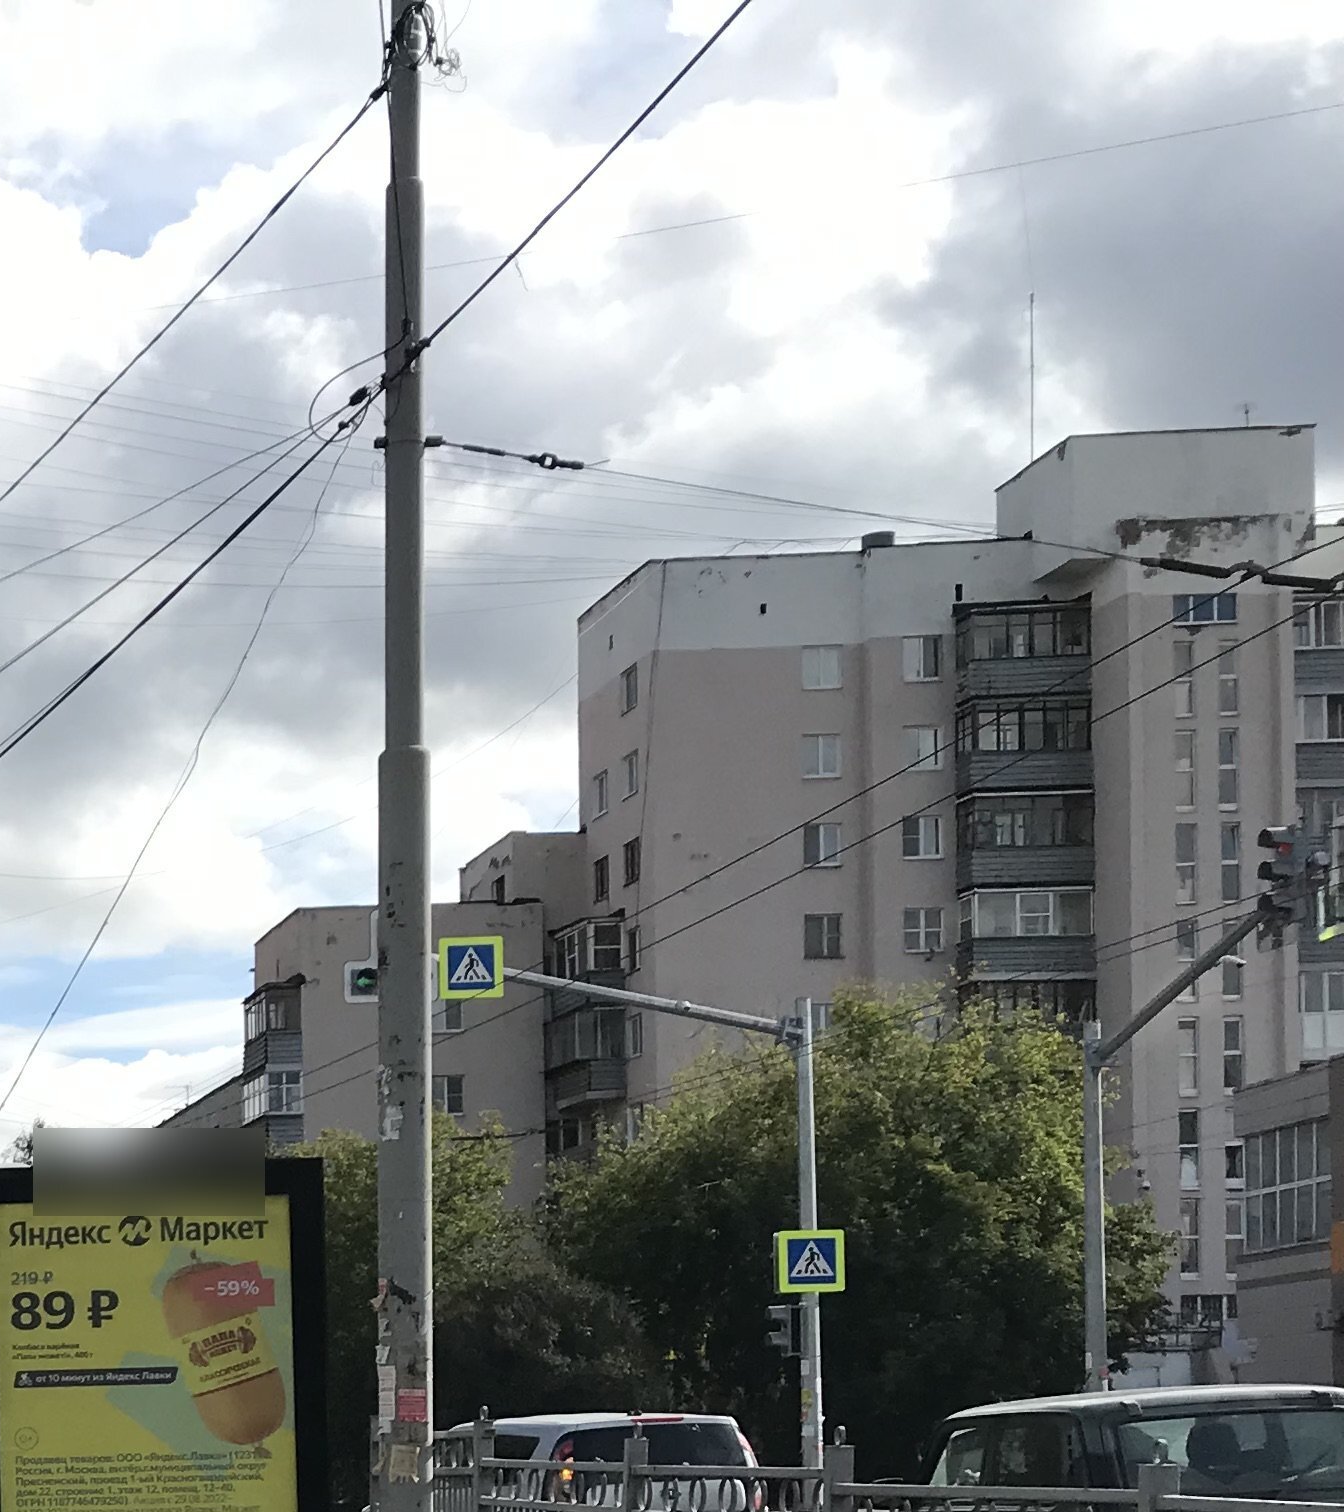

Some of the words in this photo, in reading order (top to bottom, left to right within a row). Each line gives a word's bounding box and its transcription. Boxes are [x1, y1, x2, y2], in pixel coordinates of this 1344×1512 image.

[9, 1221, 111, 1249] Яндекс
[161, 1216, 269, 1246] Маркет
[11, 1271, 39, 1285] 219
[11, 1290, 75, 1330] 89
[35, 1375, 47, 1383] от
[48, 1374, 59, 1382] 10
[61, 1373, 91, 1385] минут
[106, 1371, 140, 1382] Яндекс
[142, 1370, 172, 1380] Лавки
[116, 1453, 142, 1462] ООО
